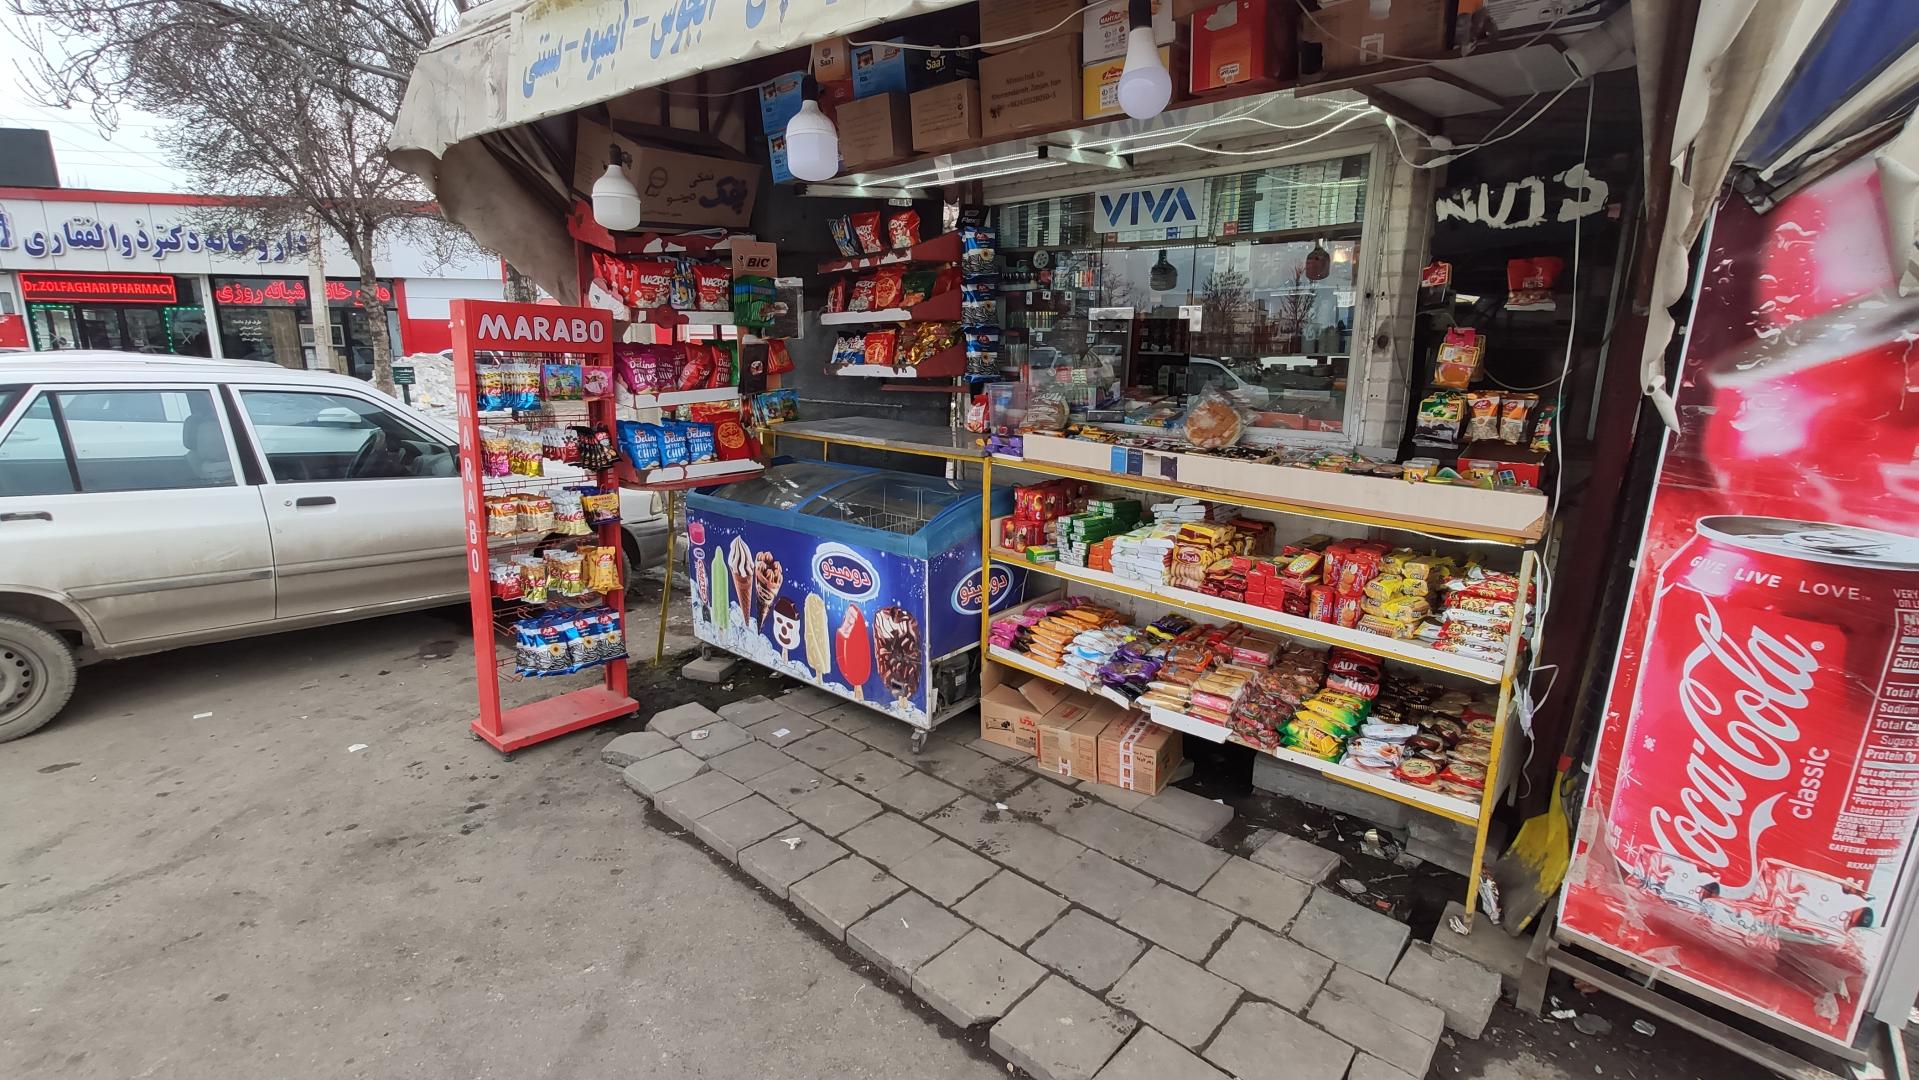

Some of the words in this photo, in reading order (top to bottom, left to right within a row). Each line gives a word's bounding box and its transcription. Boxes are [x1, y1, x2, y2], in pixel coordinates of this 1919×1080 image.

[925, 55, 945, 71] SaaT
[1100, 186, 1197, 227] VIVA
[152, 223, 201, 258] دکتر
[747, 257, 770, 268] BIC
[24, 280, 111, 294] Dr.ZOLFAGHARI
[112, 284, 174, 295] PHARMACY
[215, 283, 264, 304] روزی
[477, 313, 604, 343] MARABO
[629, 360, 657, 368] Delina
[634, 373, 658, 383] CHIPS
[686, 430, 712, 439] Delina
[637, 449, 660, 459] CHIP
[690, 442, 713, 453] CHIPS
[457, 392, 481, 574] MARABO
[821, 558, 872, 588] دومینو
[1690, 555, 1726, 575] GIVE
[1734, 567, 1783, 588] LIVE
[1798, 579, 1860, 601] LOVE
[959, 574, 1008, 607] دوینو
[1461, 604, 1495, 615] Record
[1885, 686, 1914, 697] Total
[1879, 703, 1919, 715] Sodium
[1650, 594, 1820, 868] Coca-Cola
[1875, 719, 1903, 730] Total
[1880, 735, 1914, 748] Sugars
[1864, 748, 1904, 761] Protein
[1787, 746, 1830, 820] classic
